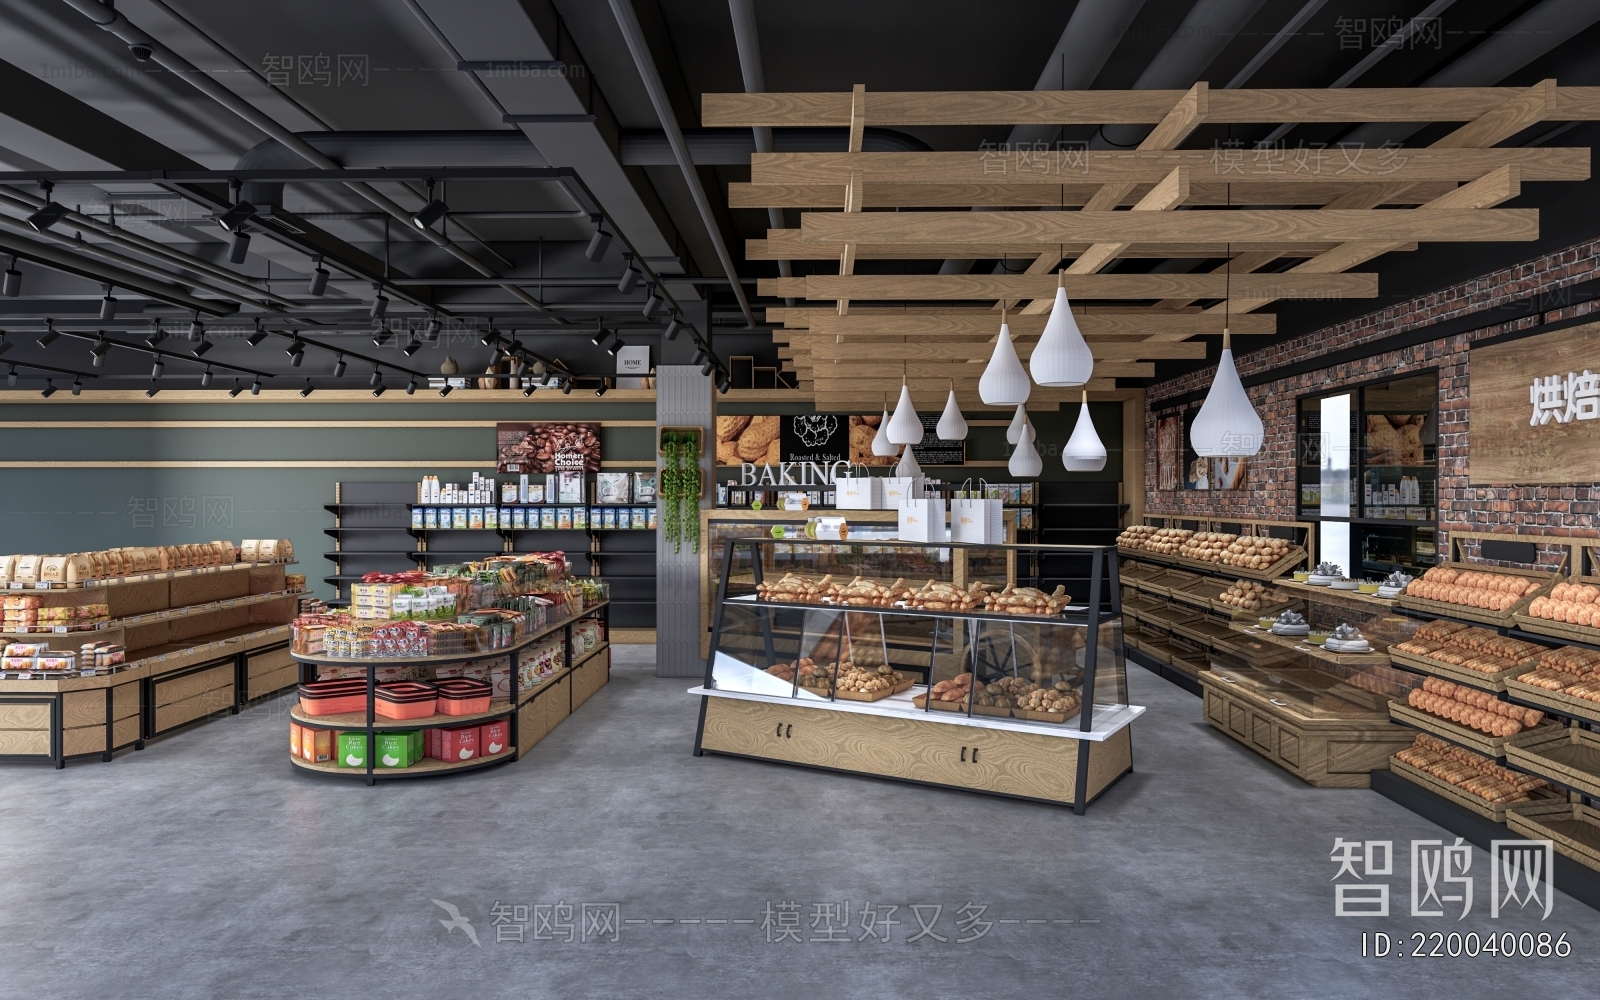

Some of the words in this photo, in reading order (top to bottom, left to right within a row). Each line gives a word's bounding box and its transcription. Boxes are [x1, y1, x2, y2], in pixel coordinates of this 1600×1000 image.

[1529, 369, 1600, 427] 烘焙
[554, 458, 584, 466] Choice
[789, 453, 813, 461] Roasted
[815, 453, 820, 461] &
[822, 453, 841, 461] Salted
[740, 460, 852, 487] BAKING
